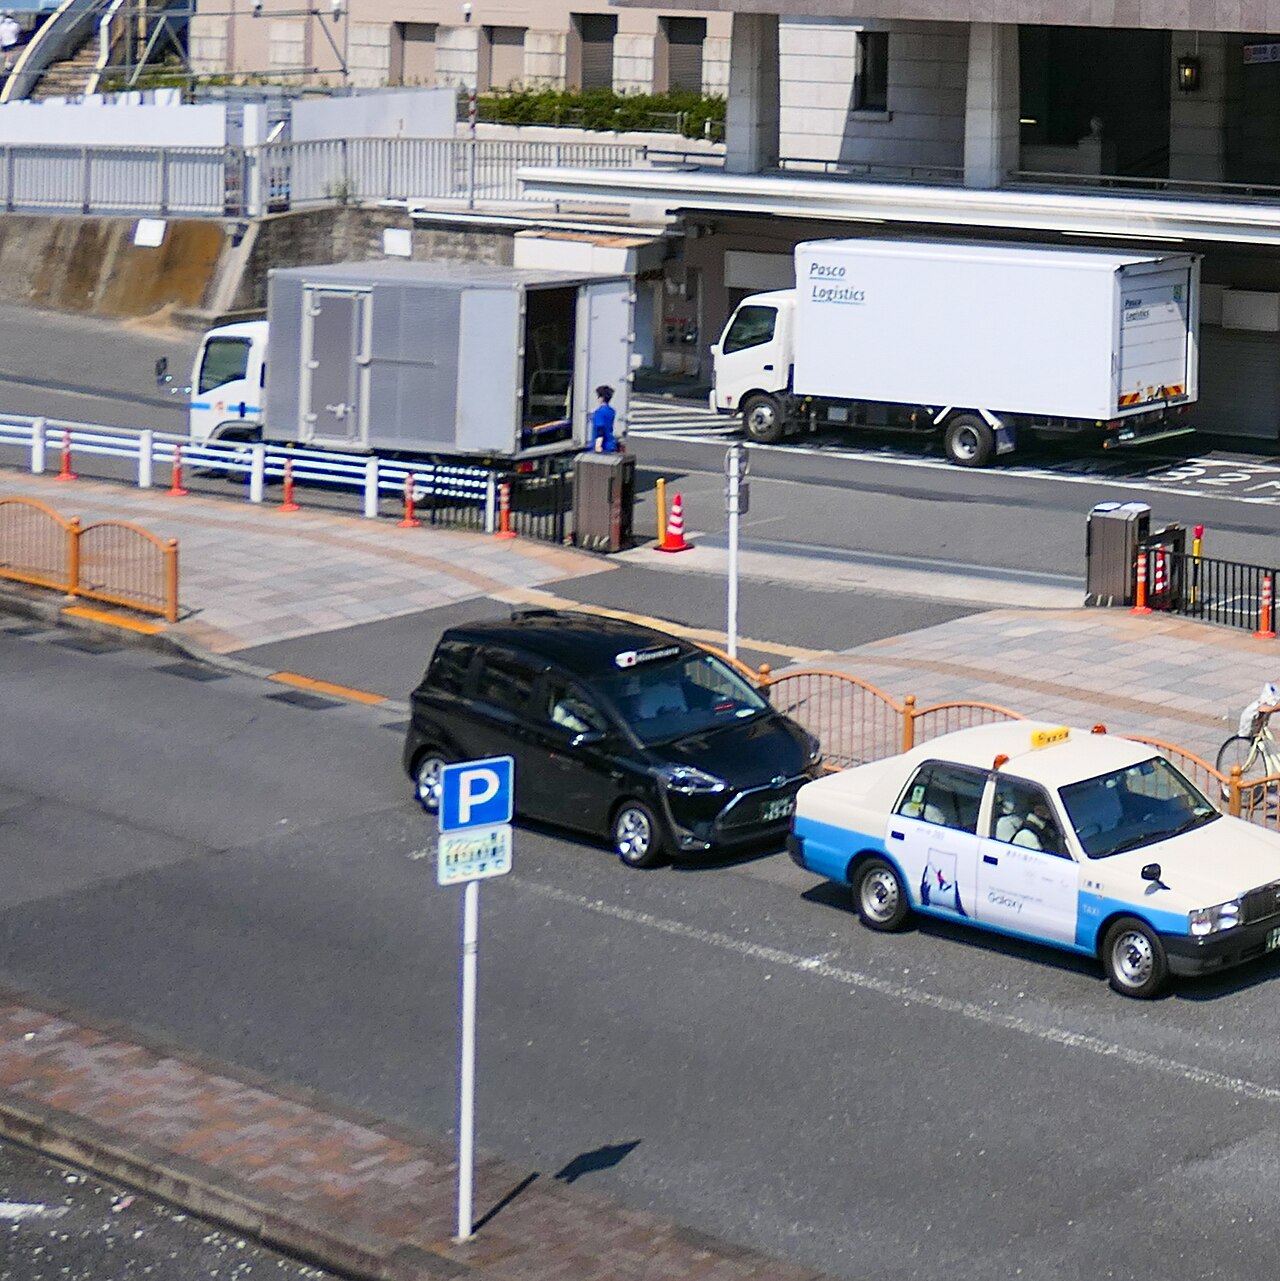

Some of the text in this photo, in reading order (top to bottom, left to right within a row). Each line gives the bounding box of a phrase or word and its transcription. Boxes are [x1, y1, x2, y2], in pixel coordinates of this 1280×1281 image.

[810, 262, 846, 277] Pasco
[812, 285, 865, 302] Logistics
[458, 768, 501, 825] P
[988, 892, 1023, 914] Galaxy
